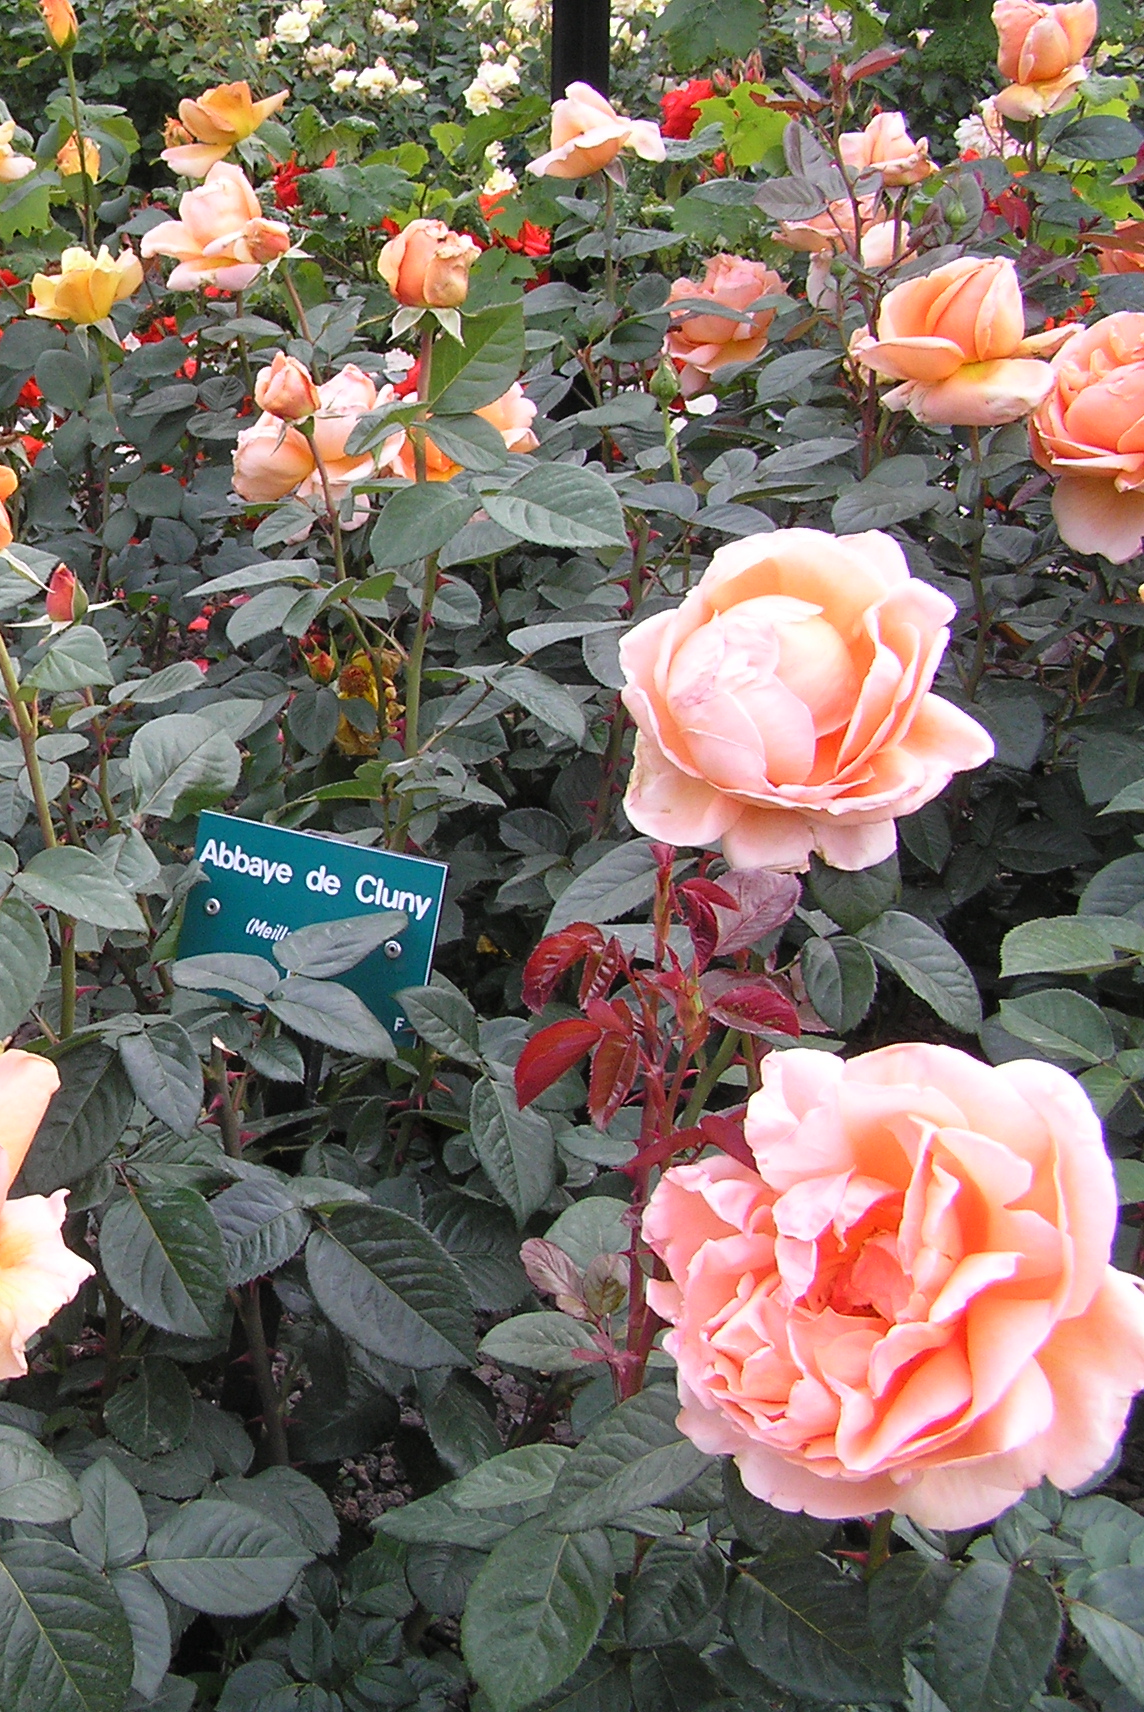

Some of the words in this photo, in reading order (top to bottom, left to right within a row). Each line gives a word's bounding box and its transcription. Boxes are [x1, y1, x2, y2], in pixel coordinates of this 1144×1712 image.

[199, 838, 293, 884] Abbaye
[306, 865, 341, 896] de
[355, 874, 432, 920] Cluny
[245, 917, 293, 941] (Meill
